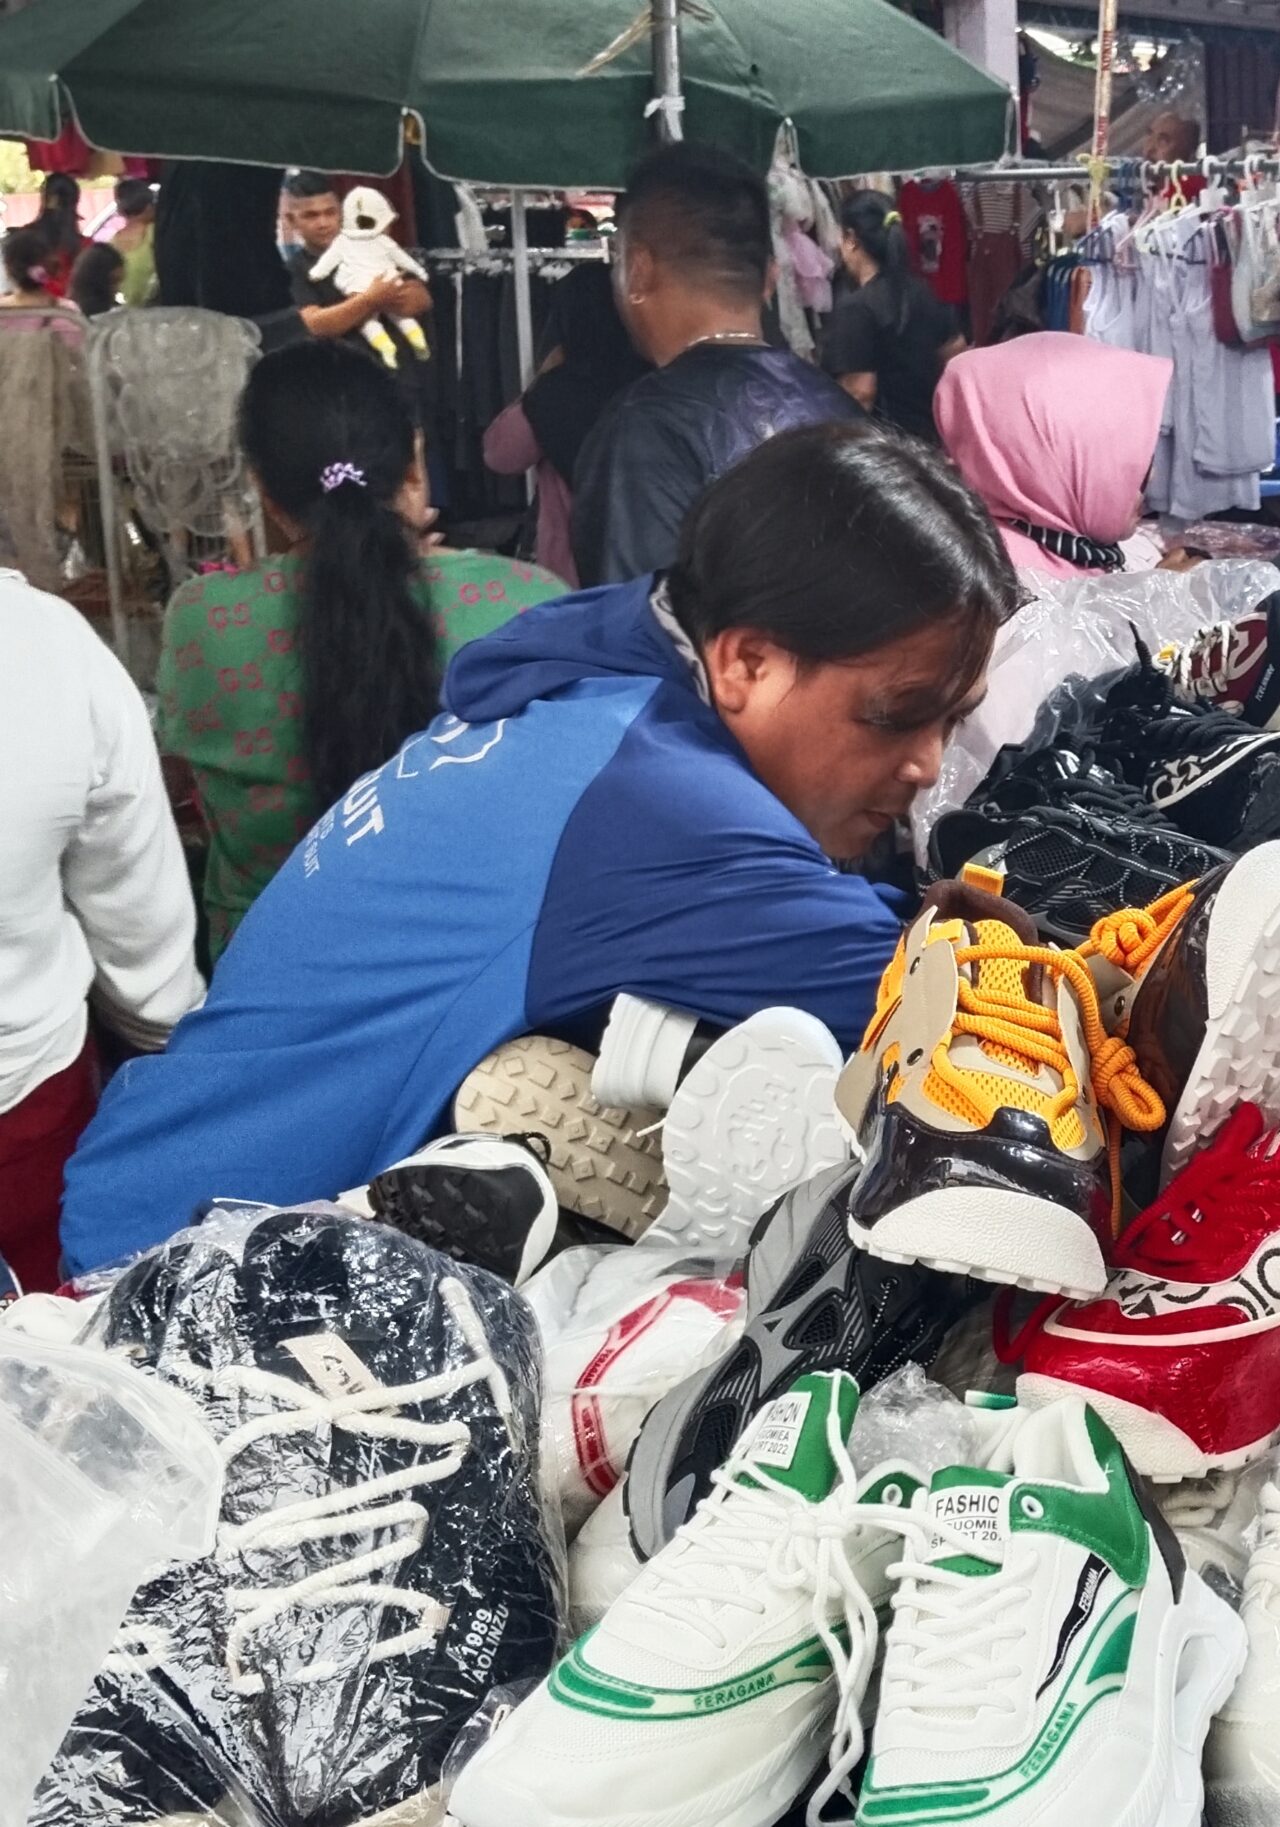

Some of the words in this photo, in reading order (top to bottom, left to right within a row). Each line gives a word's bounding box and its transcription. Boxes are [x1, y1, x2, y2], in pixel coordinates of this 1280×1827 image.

[936, 1494, 999, 1518] FASHIO
[461, 1608, 492, 1656] 1989
[472, 1603, 509, 1684] AOLINZU
[693, 1671, 776, 1709] FERAGANA
